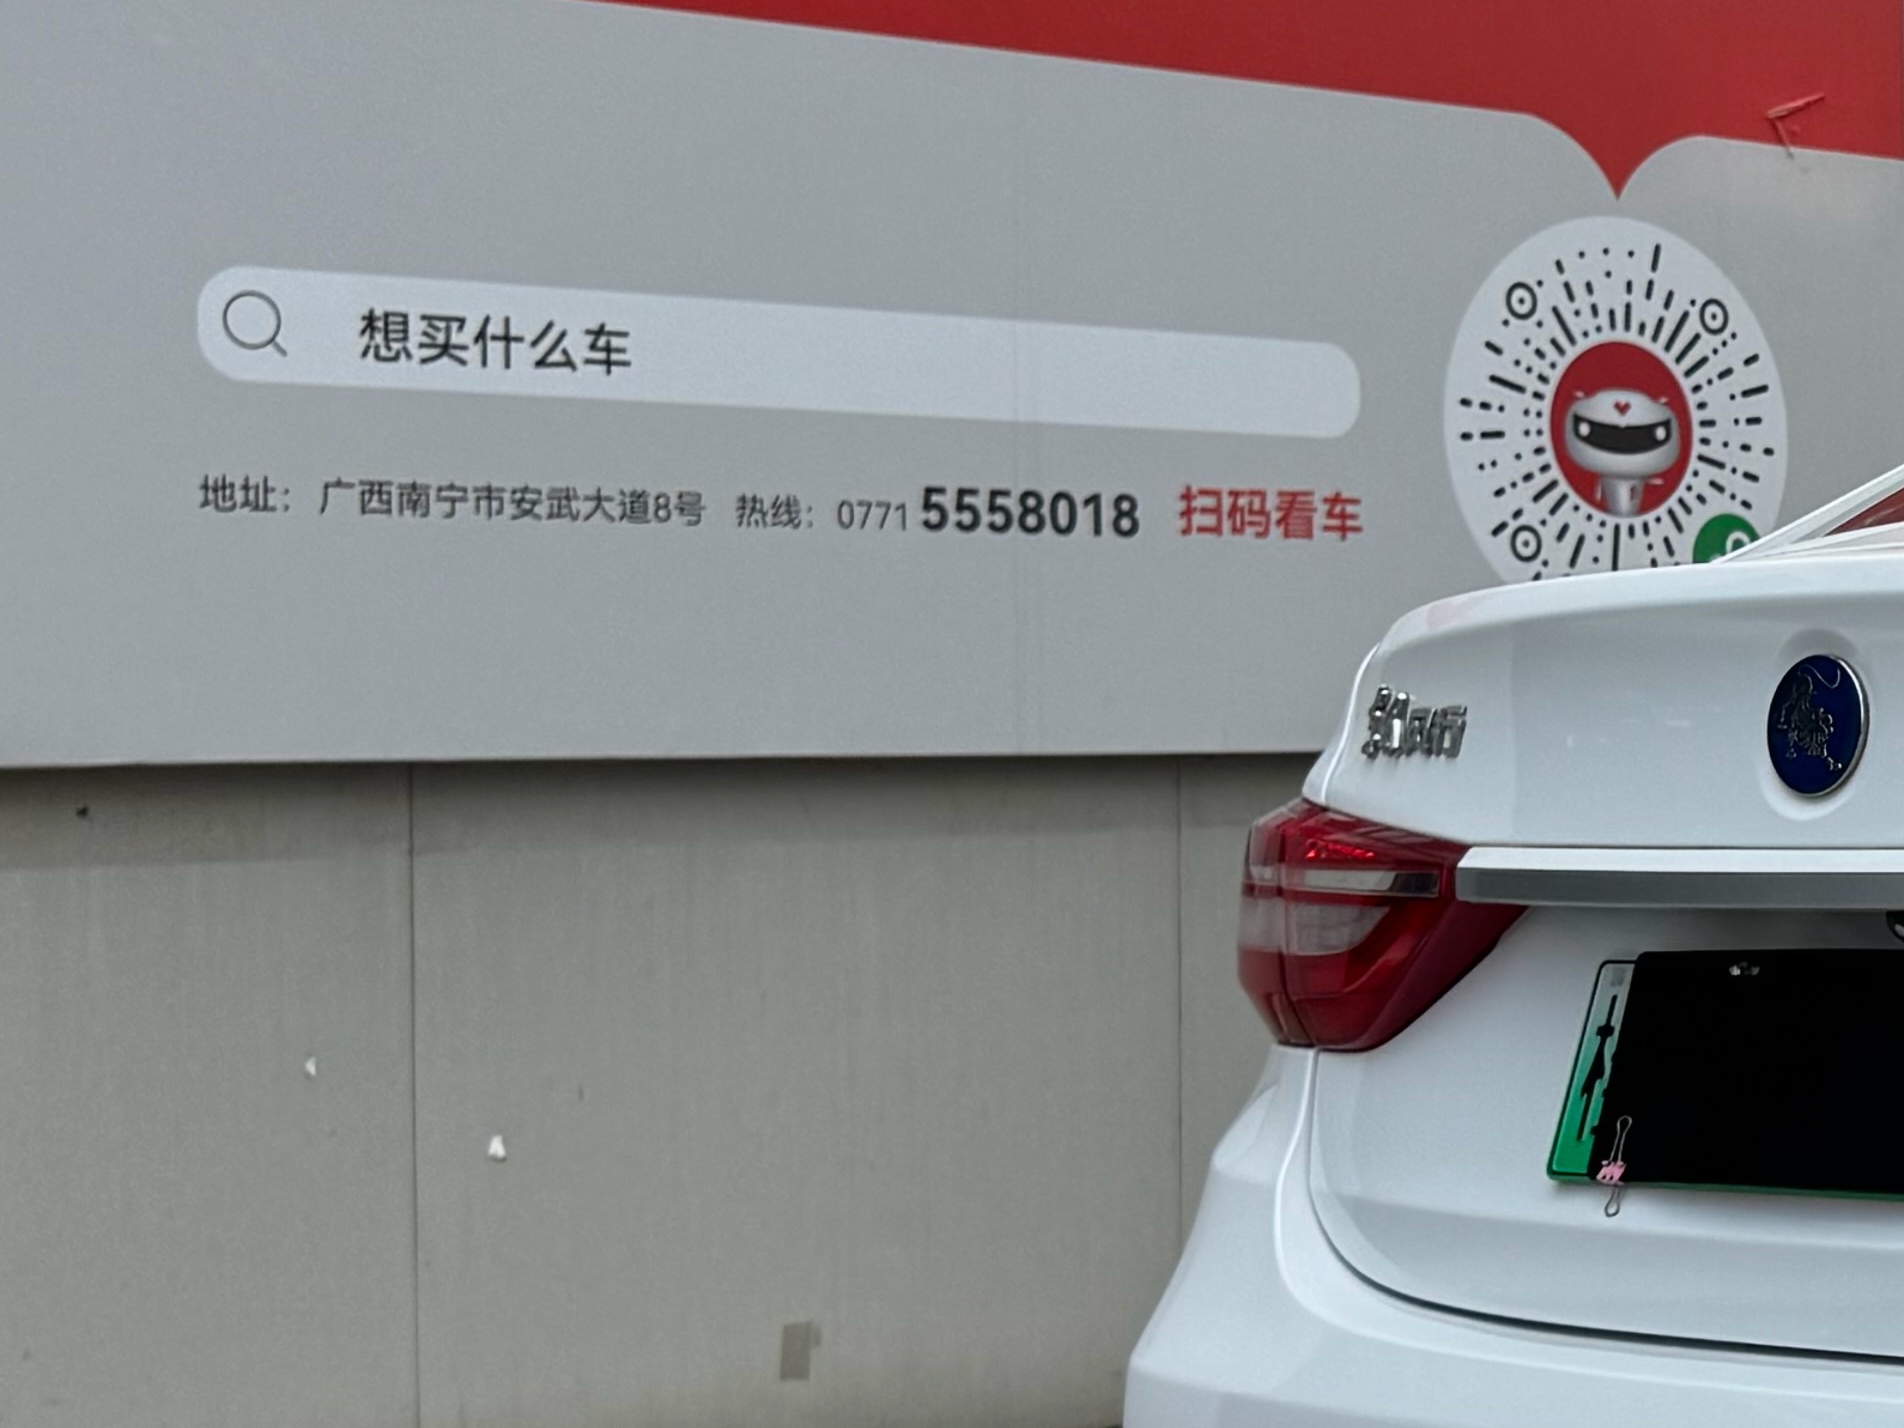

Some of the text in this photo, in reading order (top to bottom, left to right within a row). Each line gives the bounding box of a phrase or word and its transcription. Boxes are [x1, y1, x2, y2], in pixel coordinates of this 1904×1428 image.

[358, 306, 632, 376] 想买什么车
[919, 485, 1140, 538] 5558018
[1178, 484, 1364, 540] 扫码看车
